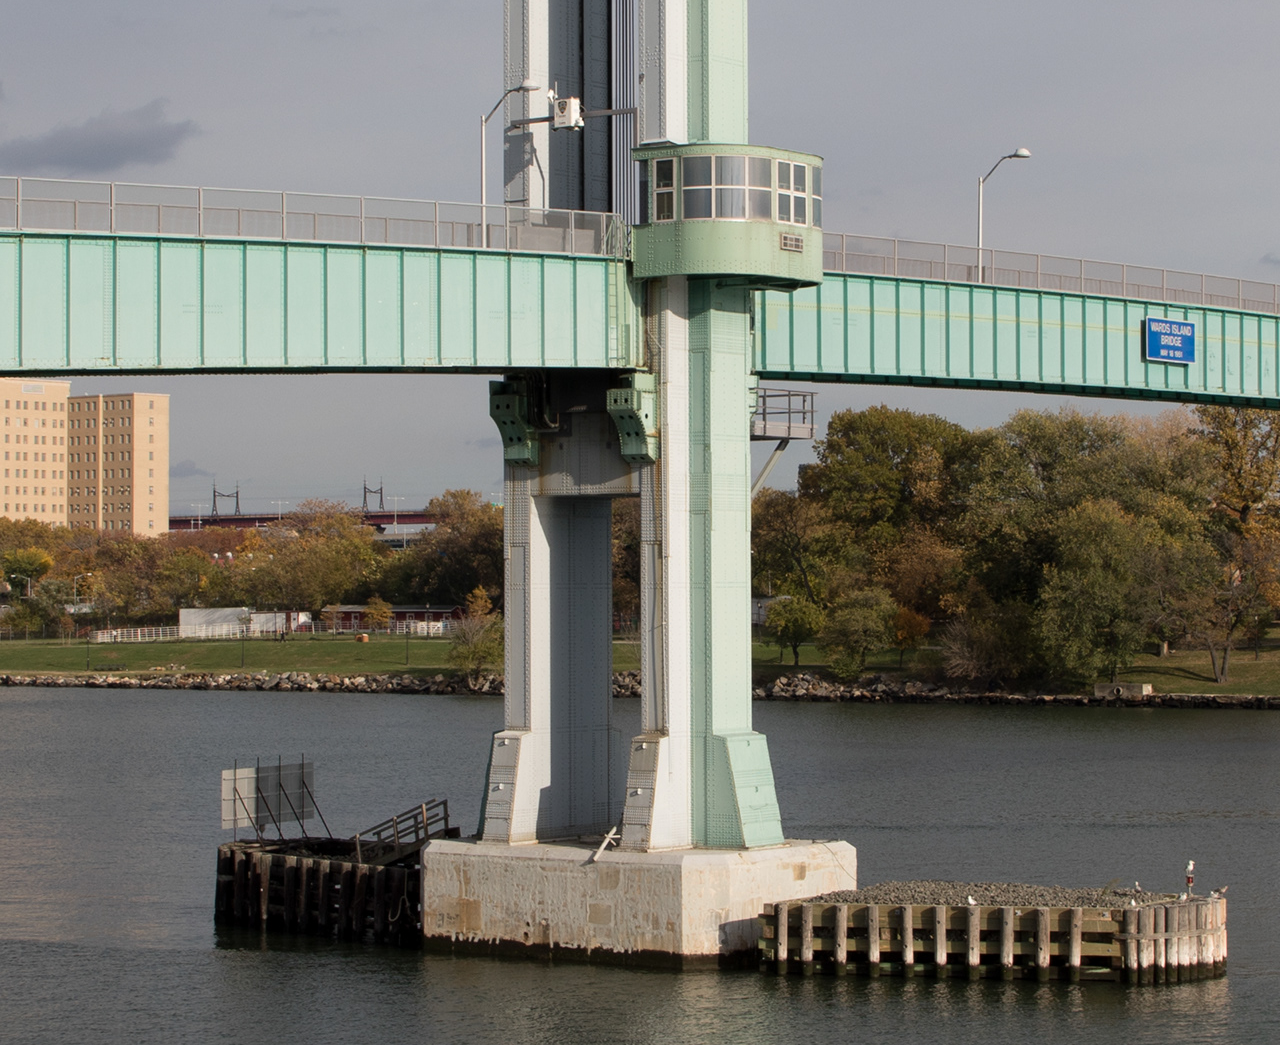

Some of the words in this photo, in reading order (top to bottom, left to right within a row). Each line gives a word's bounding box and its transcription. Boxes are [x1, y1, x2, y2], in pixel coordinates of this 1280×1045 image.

[1150, 321, 1171, 333] WARDS
[1172, 324, 1192, 336] ISLAND
[1161, 335, 1182, 347] BRIDGE
